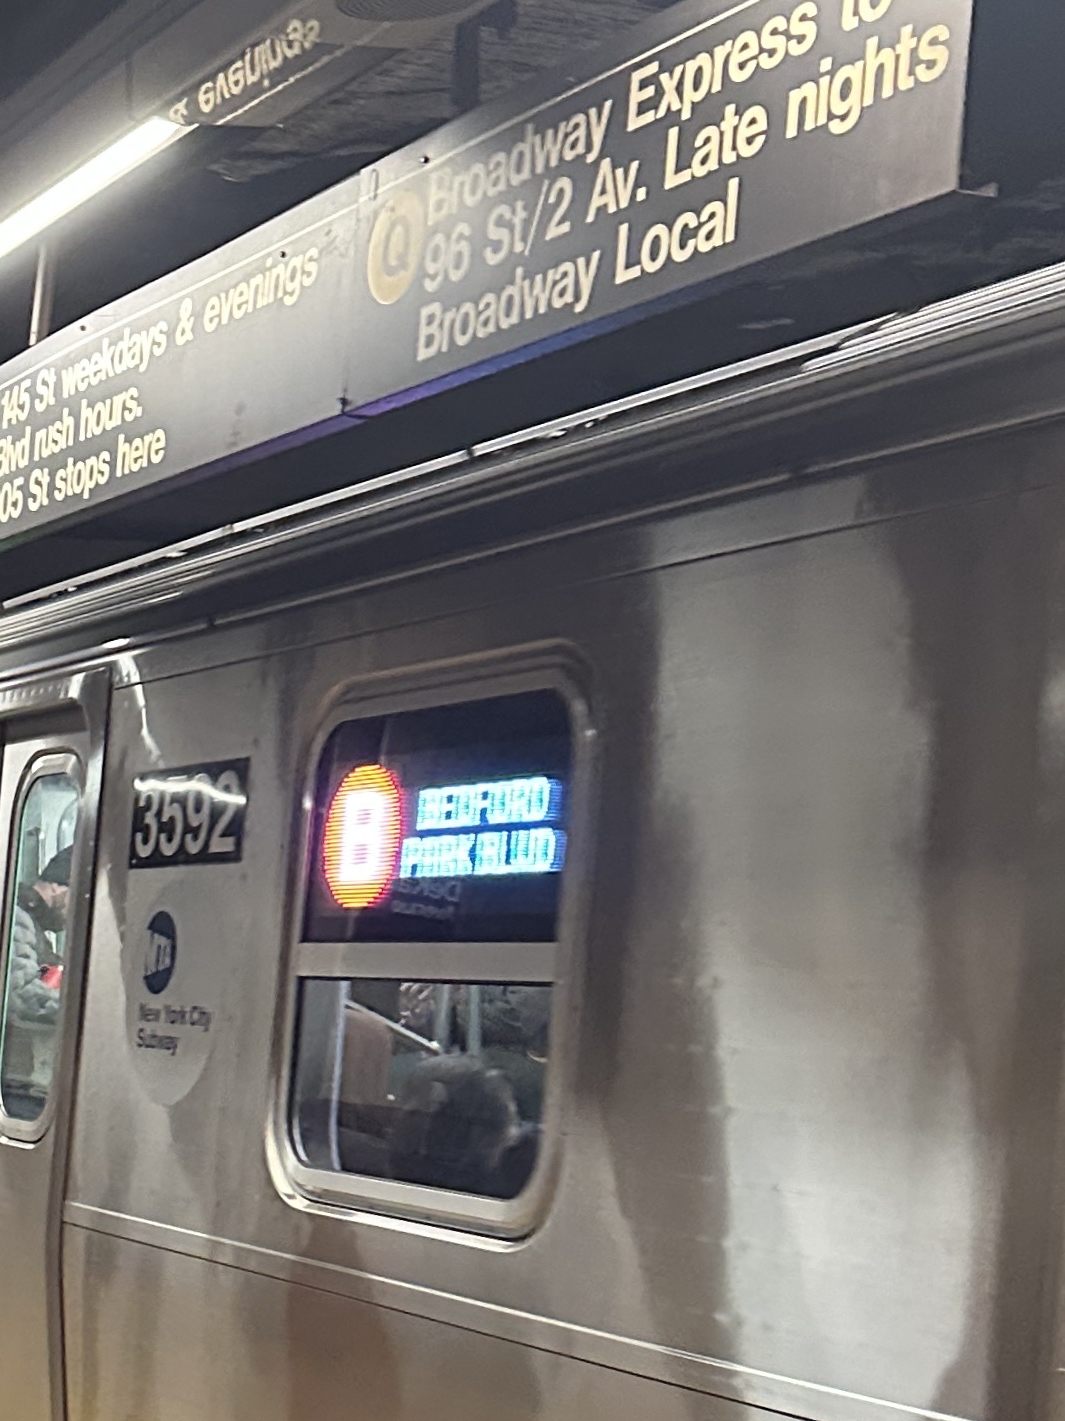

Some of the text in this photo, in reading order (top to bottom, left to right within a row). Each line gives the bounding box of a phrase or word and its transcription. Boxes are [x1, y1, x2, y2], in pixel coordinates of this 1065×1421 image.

[422, 24, 951, 293] 96 St/2 Av. Late nights
[427, 1, 818, 226] Broadway Express
[1, 377, 31, 430] 145
[34, 368, 57, 413] St
[61, 320, 169, 399] weekdays
[175, 298, 195, 346] &
[203, 248, 319, 334] evenings
[416, 177, 740, 362] Broadway Local
[28, 468, 50, 511] St
[54, 451, 111, 499] stops
[116, 429, 166, 477] here
[34, 408, 74, 461] rush
[79, 387, 142, 441] hours.
[135, 769, 239, 858] 3592
